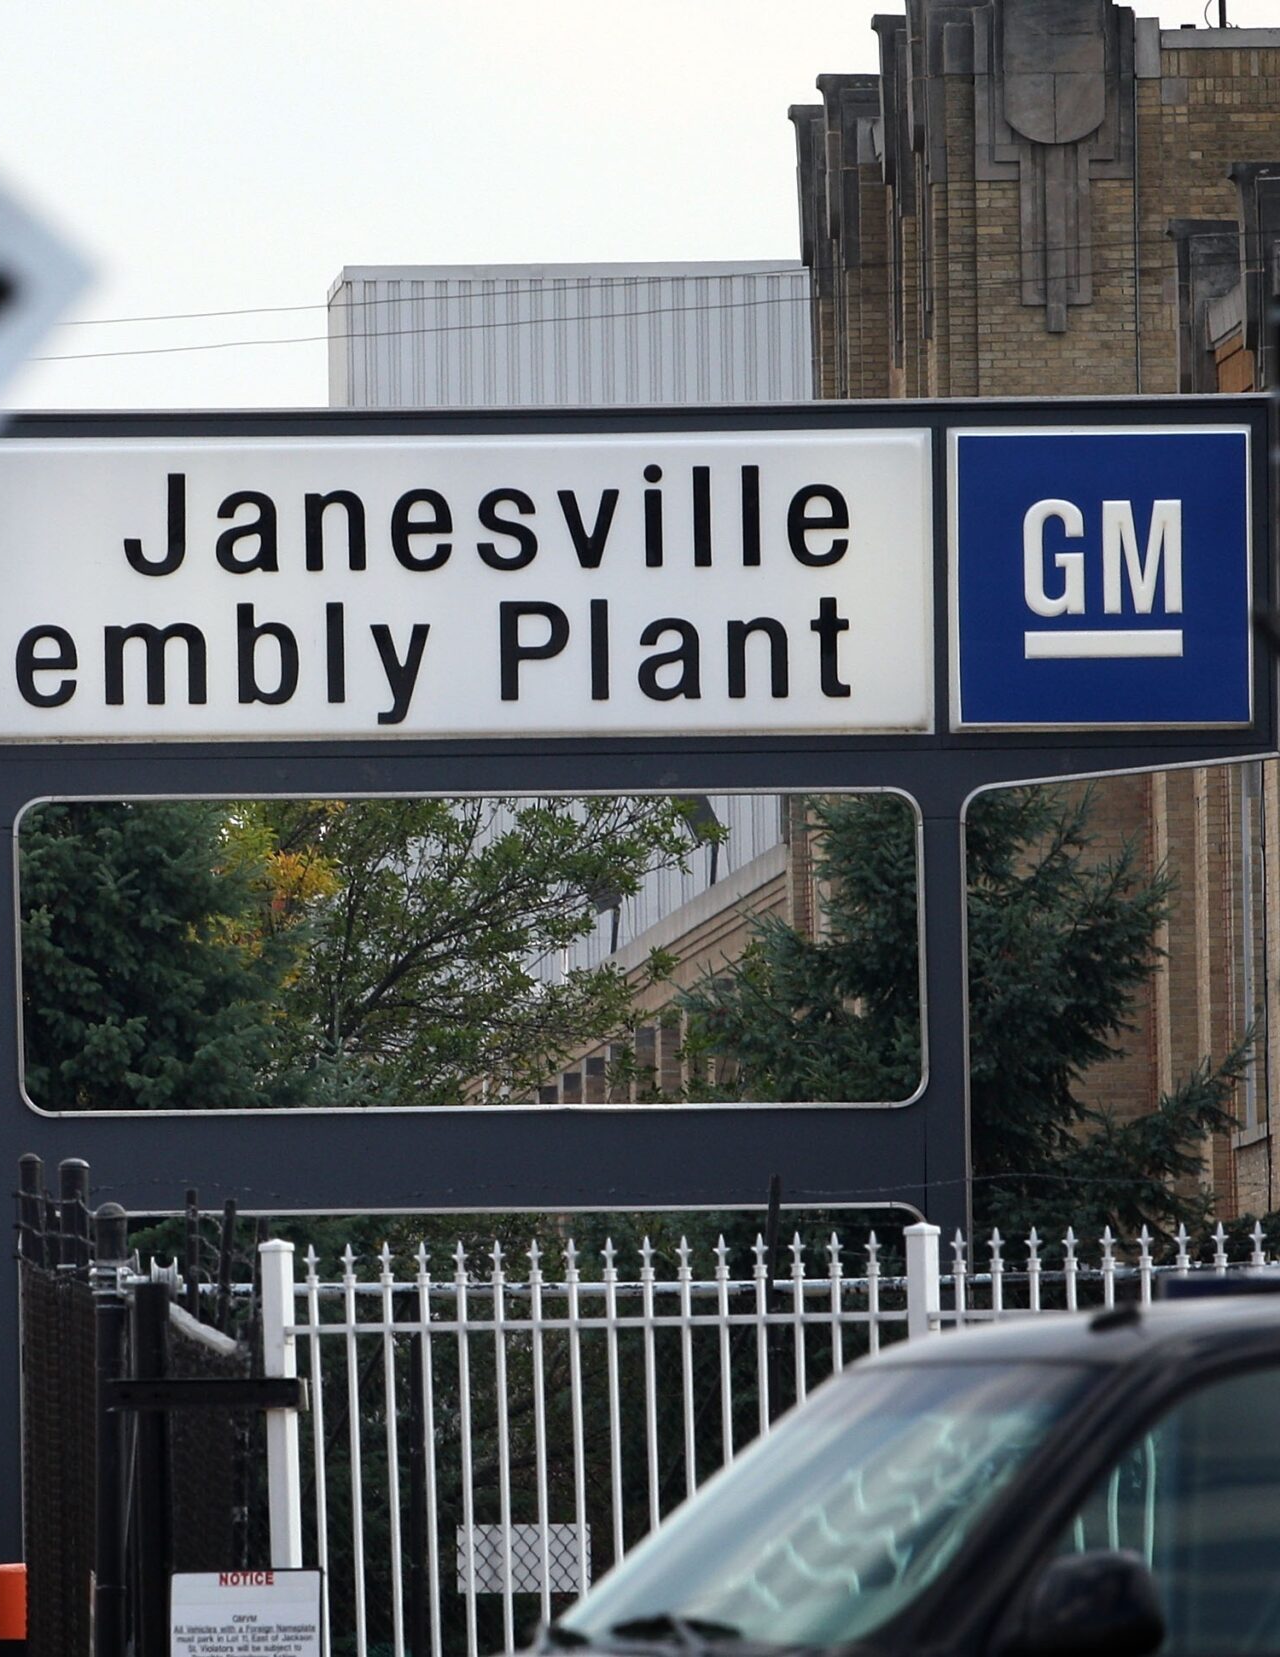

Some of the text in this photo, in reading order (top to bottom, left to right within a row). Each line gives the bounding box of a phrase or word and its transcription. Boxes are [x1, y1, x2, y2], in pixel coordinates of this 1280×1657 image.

[123, 463, 851, 577] Janesville
[1022, 498, 1183, 617] GM
[499, 596, 852, 701] Plant
[219, 1571, 275, 1586] NOTICE
[220, 1625, 237, 1634] with
